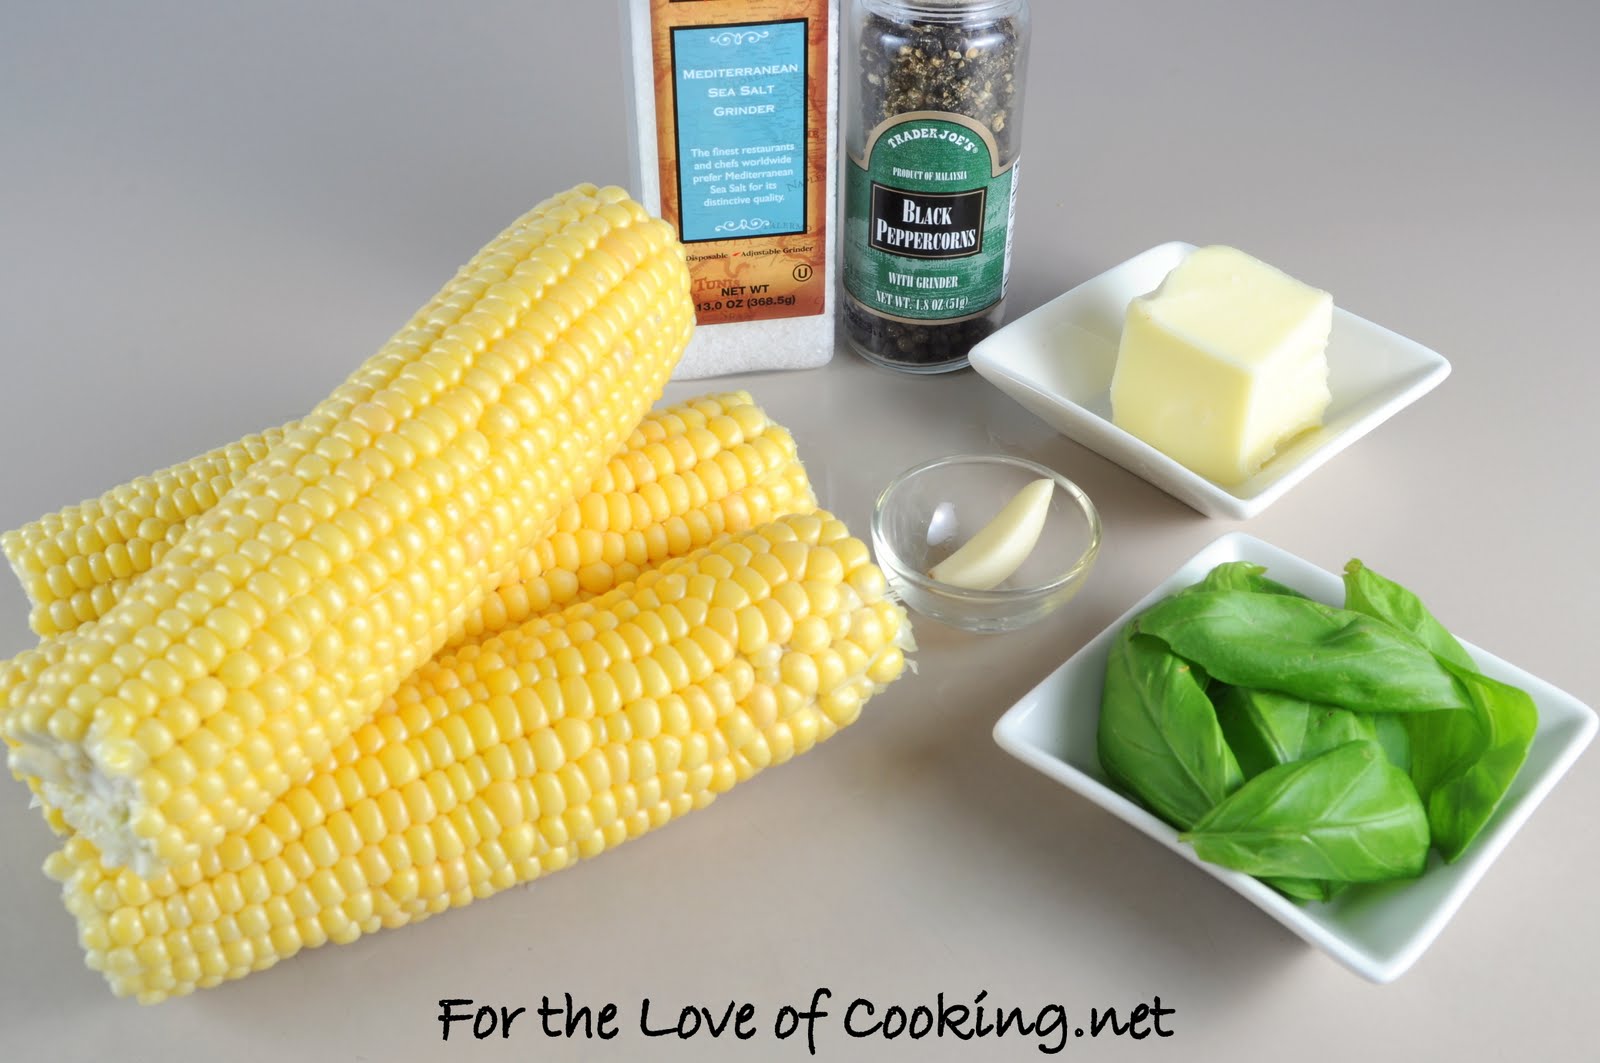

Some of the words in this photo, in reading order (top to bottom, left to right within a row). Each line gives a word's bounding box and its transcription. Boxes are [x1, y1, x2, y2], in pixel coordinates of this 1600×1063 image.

[683, 64, 799, 80] MEDITERRANEAN
[708, 88, 736, 98] SEA
[740, 85, 775, 96] SALT
[713, 105, 775, 117] GRINDER
[887, 128, 938, 149] TRADER
[690, 148, 710, 158] The
[712, 147, 739, 156] finest
[741, 143, 795, 155] restaurants
[694, 161, 712, 170] and
[714, 158, 739, 168] chefs
[742, 156, 792, 167] worldwide
[693, 175, 722, 185] prefer
[725, 169, 793, 181] Mediterranean
[892, 167, 923, 180] PRODUCT
[924, 171, 933, 180] OF
[935, 171, 967, 180] MALAYSIA
[710, 185, 727, 194] Sea
[729, 183, 747, 193] Salt
[749, 182, 763, 191] for
[765, 182, 777, 190] its
[704, 196, 751, 207] distinctive
[753, 193, 785, 204] quality.
[902, 199, 952, 225] BLACK
[876, 218, 976, 251] PEPPERCORNS
[686, 252, 728, 262] Disposable
[741, 248, 781, 258] Adjustable
[783, 245, 814, 254] Grinder
[888, 271, 914, 287] WITH
[916, 275, 958, 289] GRINDER
[721, 286, 747, 297] NET
[750, 284, 770, 294] WT
[696, 301, 722, 312] 13.0
[726, 299, 744, 309] OZ
[747, 294, 796, 309] (368.5g)
[875, 290, 891, 304] NET
[915, 298, 929, 311] 1.8
[931, 299, 944, 311] OZ
[945, 295, 969, 309] (51g)
